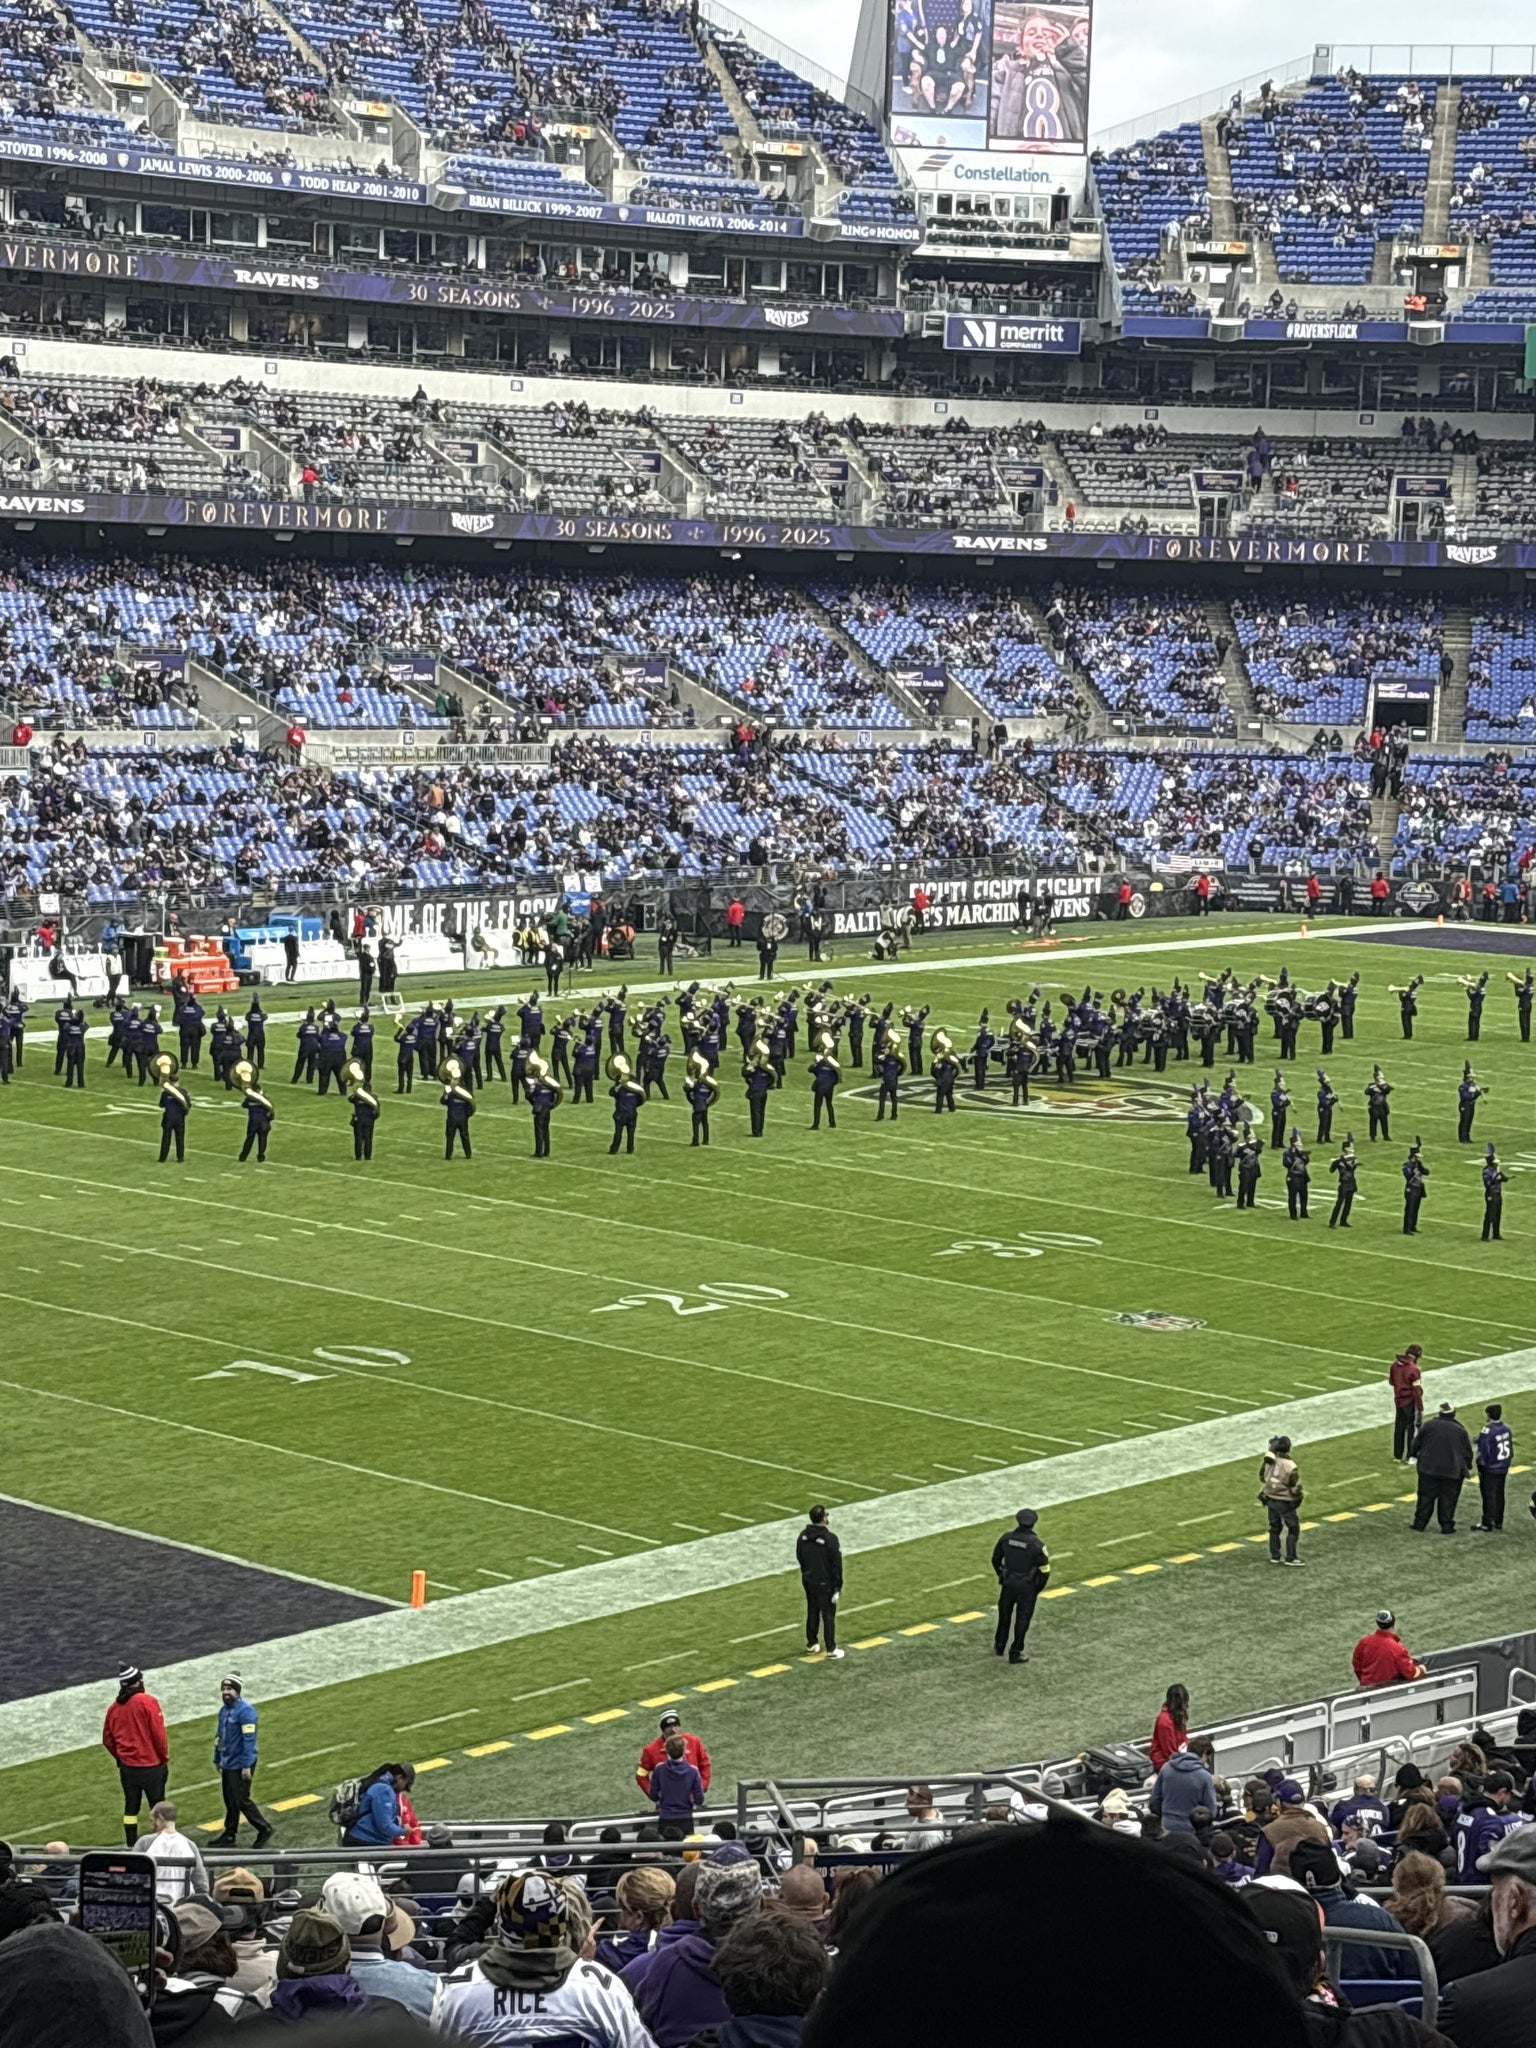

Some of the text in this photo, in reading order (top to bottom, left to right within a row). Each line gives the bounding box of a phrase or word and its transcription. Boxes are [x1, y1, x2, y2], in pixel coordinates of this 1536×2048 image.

[0, 141, 108, 166] STOVER 1996-2008
[139, 157, 274, 185] JAMAL LEWIS 2000-2006
[954, 163, 1051, 184] Constellation
[299, 176, 420, 200] TODD HEAP 2001-2010
[469, 194, 603, 219] BRIAN BILLICK 1999-2007
[646, 211, 787, 234] HALOTI NGATA 2006-2014
[841, 225, 869, 237] RING
[877, 227, 920, 240] HONOR
[233, 269, 320, 290] RAVENS
[407, 283, 430, 301] 30
[439, 286, 521, 309] SEASONS
[764, 307, 810, 328] RAVENS
[1000, 323, 1065, 343] merritt
[1286, 322, 1359, 340] #RAVENSFLOCK
[184, 501, 388, 530] FOREVERMORE
[451, 512, 495, 534] RAVENS
[554, 519, 576, 538] 30
[585, 522, 672, 541] SEASONS
[952, 535, 1048, 552] RAVENS
[1147, 539, 1371, 563] FOREVERMORE
[1446, 544, 1498, 565] RAVENS
[422, 903, 448, 937] OF
[453, 901, 492, 935] THE
[1050, 897, 1091, 919] AVENS
[617, 1282, 791, 1317] 20
[223, 1344, 413, 1384] 10
[1497, 1440, 1511, 1461] 25
[493, 1988, 549, 2017] RICE
